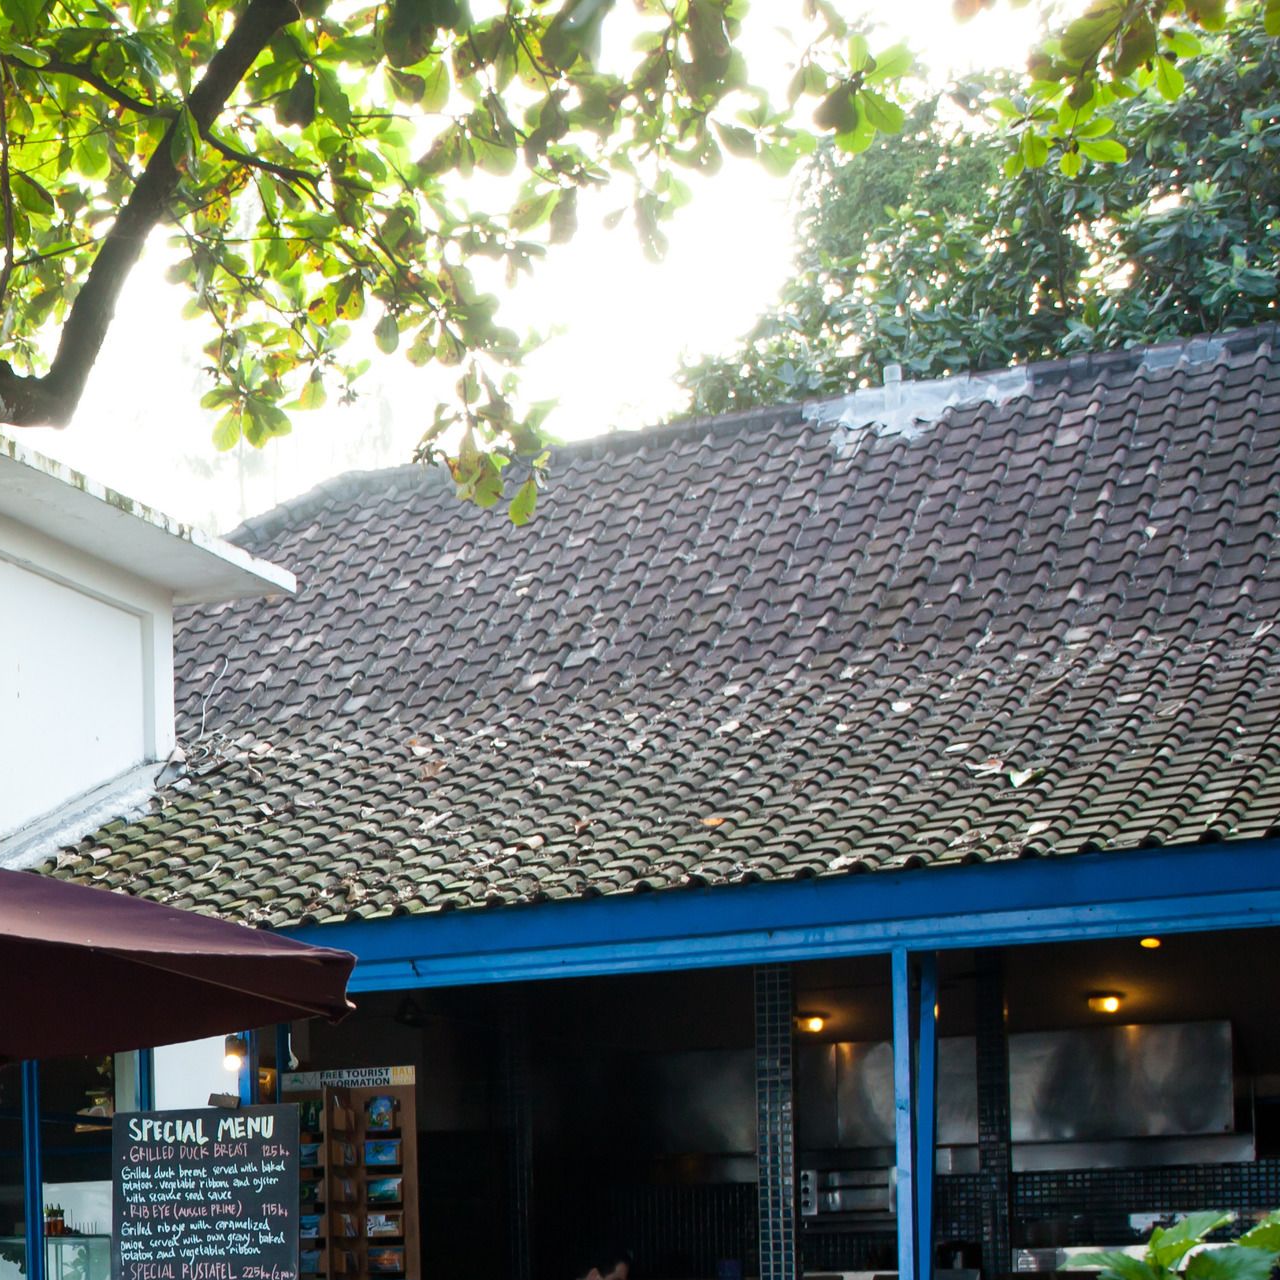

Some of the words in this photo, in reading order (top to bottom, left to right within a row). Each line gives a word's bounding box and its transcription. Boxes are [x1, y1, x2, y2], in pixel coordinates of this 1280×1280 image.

[320, 1070, 344, 1079] FREE
[347, 1068, 390, 1078] TOURIST
[320, 1077, 390, 1088] INFORMATION
[129, 1118, 209, 1145] SPECIAL
[217, 1115, 274, 1142] MENU
[130, 1145, 175, 1163] GRILLED
[180, 1146, 209, 1160] DUCK
[214, 1142, 248, 1158] BREAST
[121, 1166, 151, 1180] Grilled
[154, 1165, 175, 1178] duck
[213, 1164, 238, 1175] served
[241, 1162, 258, 1173] with
[261, 1160, 285, 1173] baked
[233, 1177, 250, 1187] and
[253, 1177, 279, 1193] oyster
[126, 1193, 146, 1203] with
[130, 1204, 149, 1219] RIB
[153, 1204, 170, 1220] EYE
[121, 1221, 152, 1236] Grilled
[190, 1220, 212, 1230] with
[150, 1237, 179, 1247] served
[183, 1235, 202, 1245] with
[207, 1231, 225, 1242] own
[259, 1232, 285, 1245] baked
[157, 1248, 175, 1259] and
[130, 1262, 175, 1280] SPECIAL
